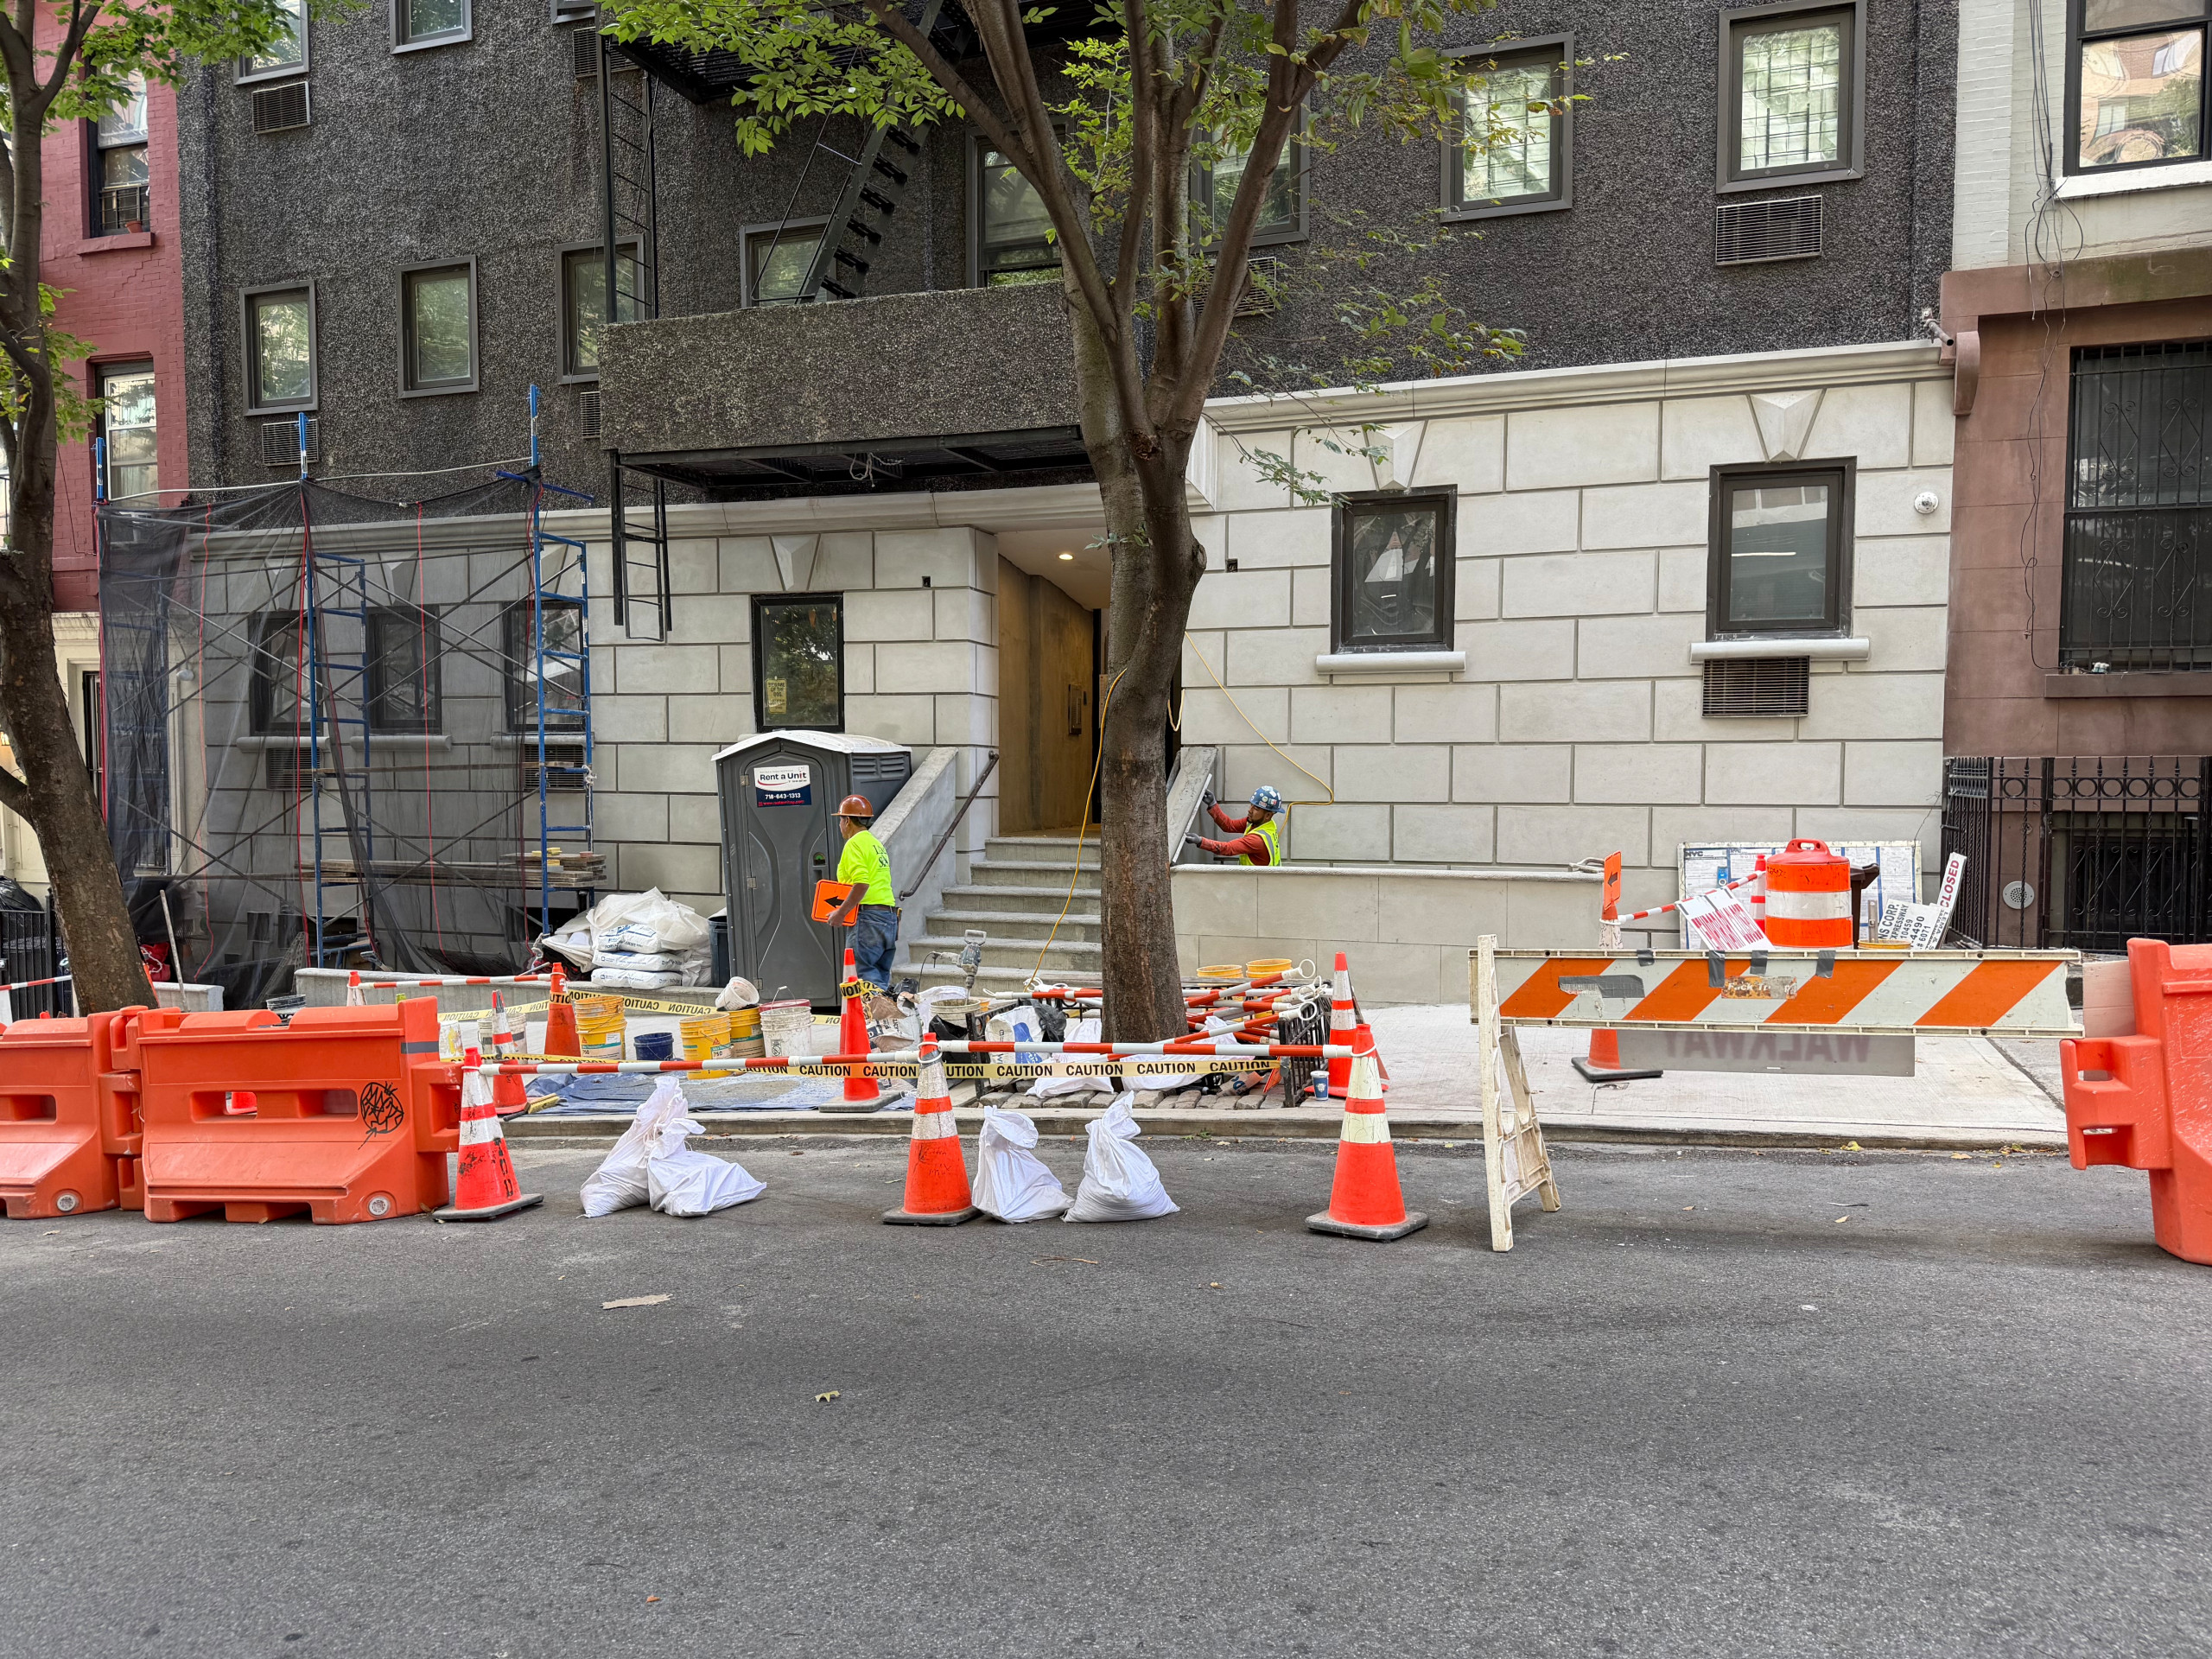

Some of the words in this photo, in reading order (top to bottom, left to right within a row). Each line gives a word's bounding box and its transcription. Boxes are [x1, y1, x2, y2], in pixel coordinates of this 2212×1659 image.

[787, 770, 807, 779] Unit
[1940, 860, 1960, 908] CLOSED
[1882, 903, 1900, 927] CORP.
[1889, 904, 1910, 940] XPRESSWAY
[1900, 918, 1913, 939] 10459
[1918, 925, 1932, 942] 6071
[799, 1065, 851, 1077] CAUTION
[863, 1065, 917, 1077] CAUTION
[946, 1065, 984, 1077] UTION
[996, 1065, 1053, 1077] CAUTION
[1065, 1063, 1123, 1077] CAUTION
[1136, 1062, 1196, 1075] CAUTION
[1210, 1060, 1270, 1072] CAUTION
